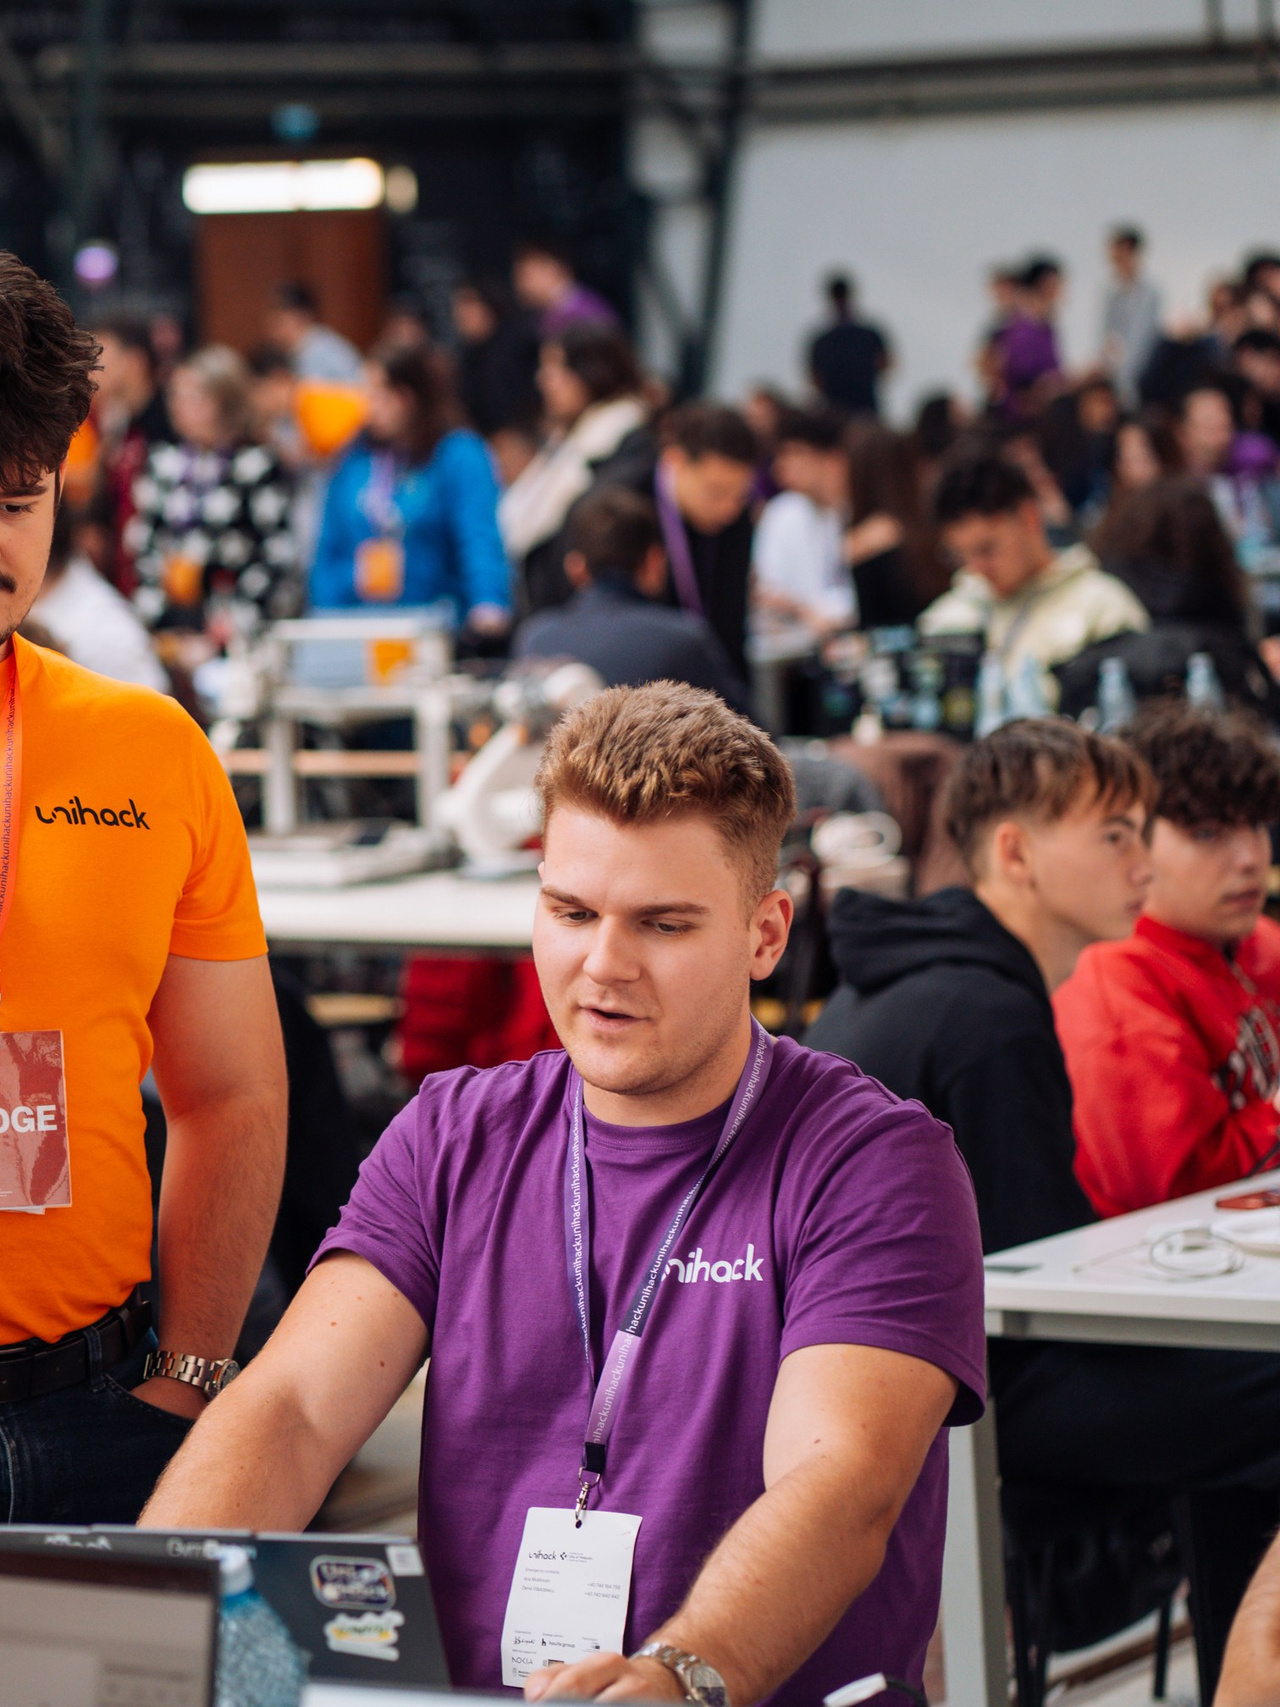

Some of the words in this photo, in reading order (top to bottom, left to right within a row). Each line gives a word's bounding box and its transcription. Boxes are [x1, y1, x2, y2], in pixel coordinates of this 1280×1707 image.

[35, 795, 151, 830] unihack
[661, 1243, 764, 1283] nihack
[528, 1549, 557, 1561] unihack
[511, 1656, 534, 1665] NOKIA
